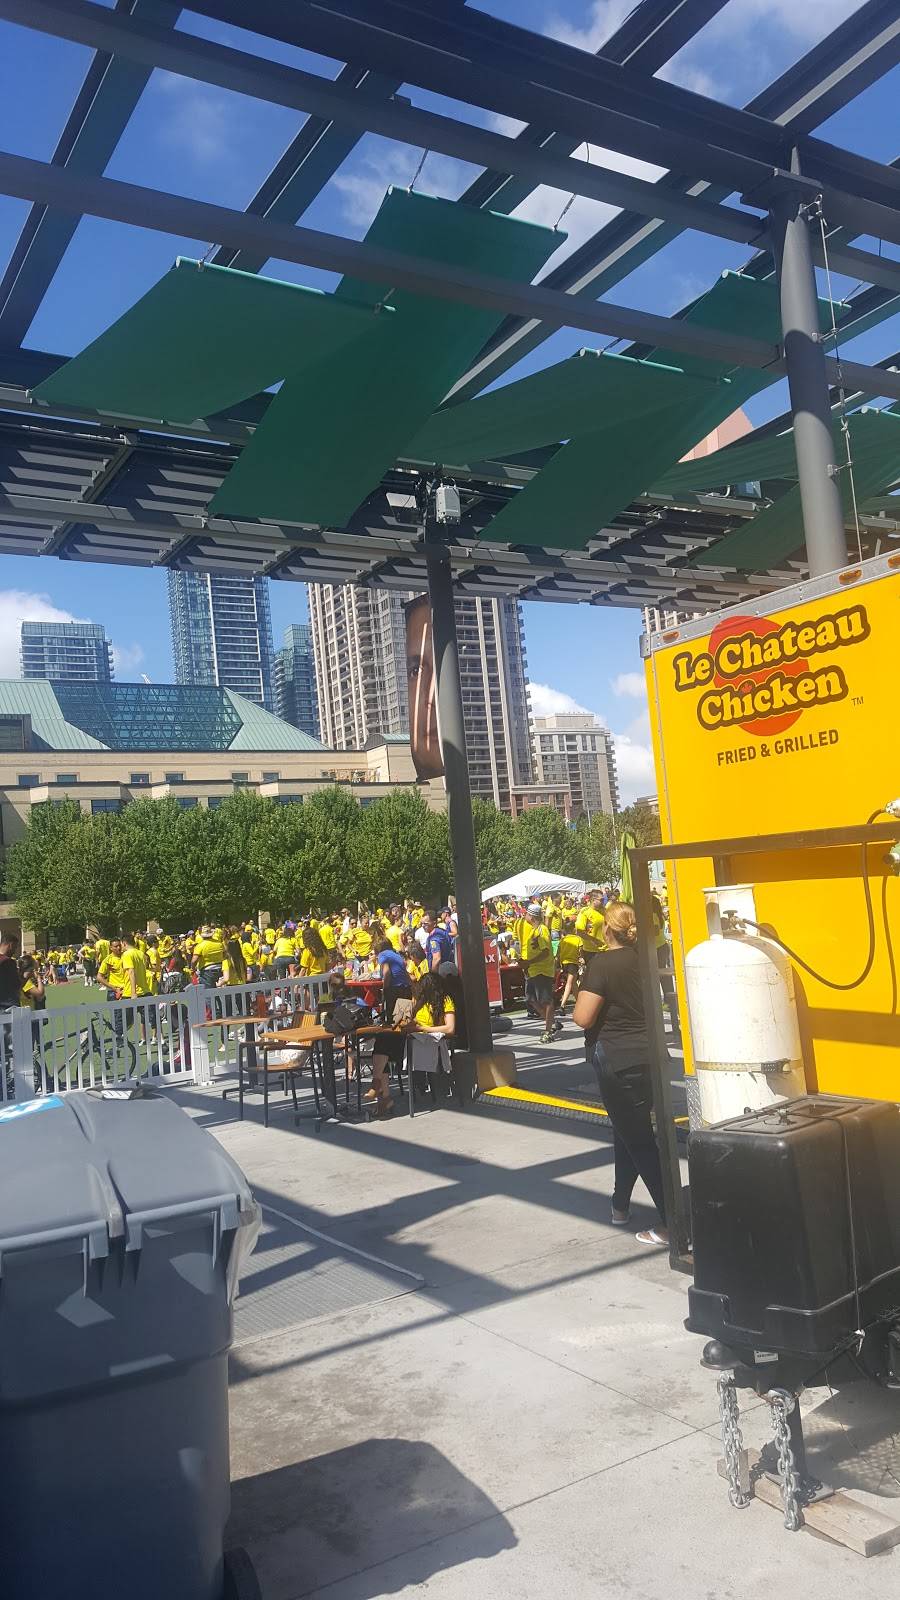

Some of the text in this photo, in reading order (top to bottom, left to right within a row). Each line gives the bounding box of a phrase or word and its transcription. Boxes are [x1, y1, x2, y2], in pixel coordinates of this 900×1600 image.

[675, 608, 867, 688] Le Chateau
[699, 668, 845, 727] Chicken
[717, 729, 839, 766] FRIED & GRILLED
